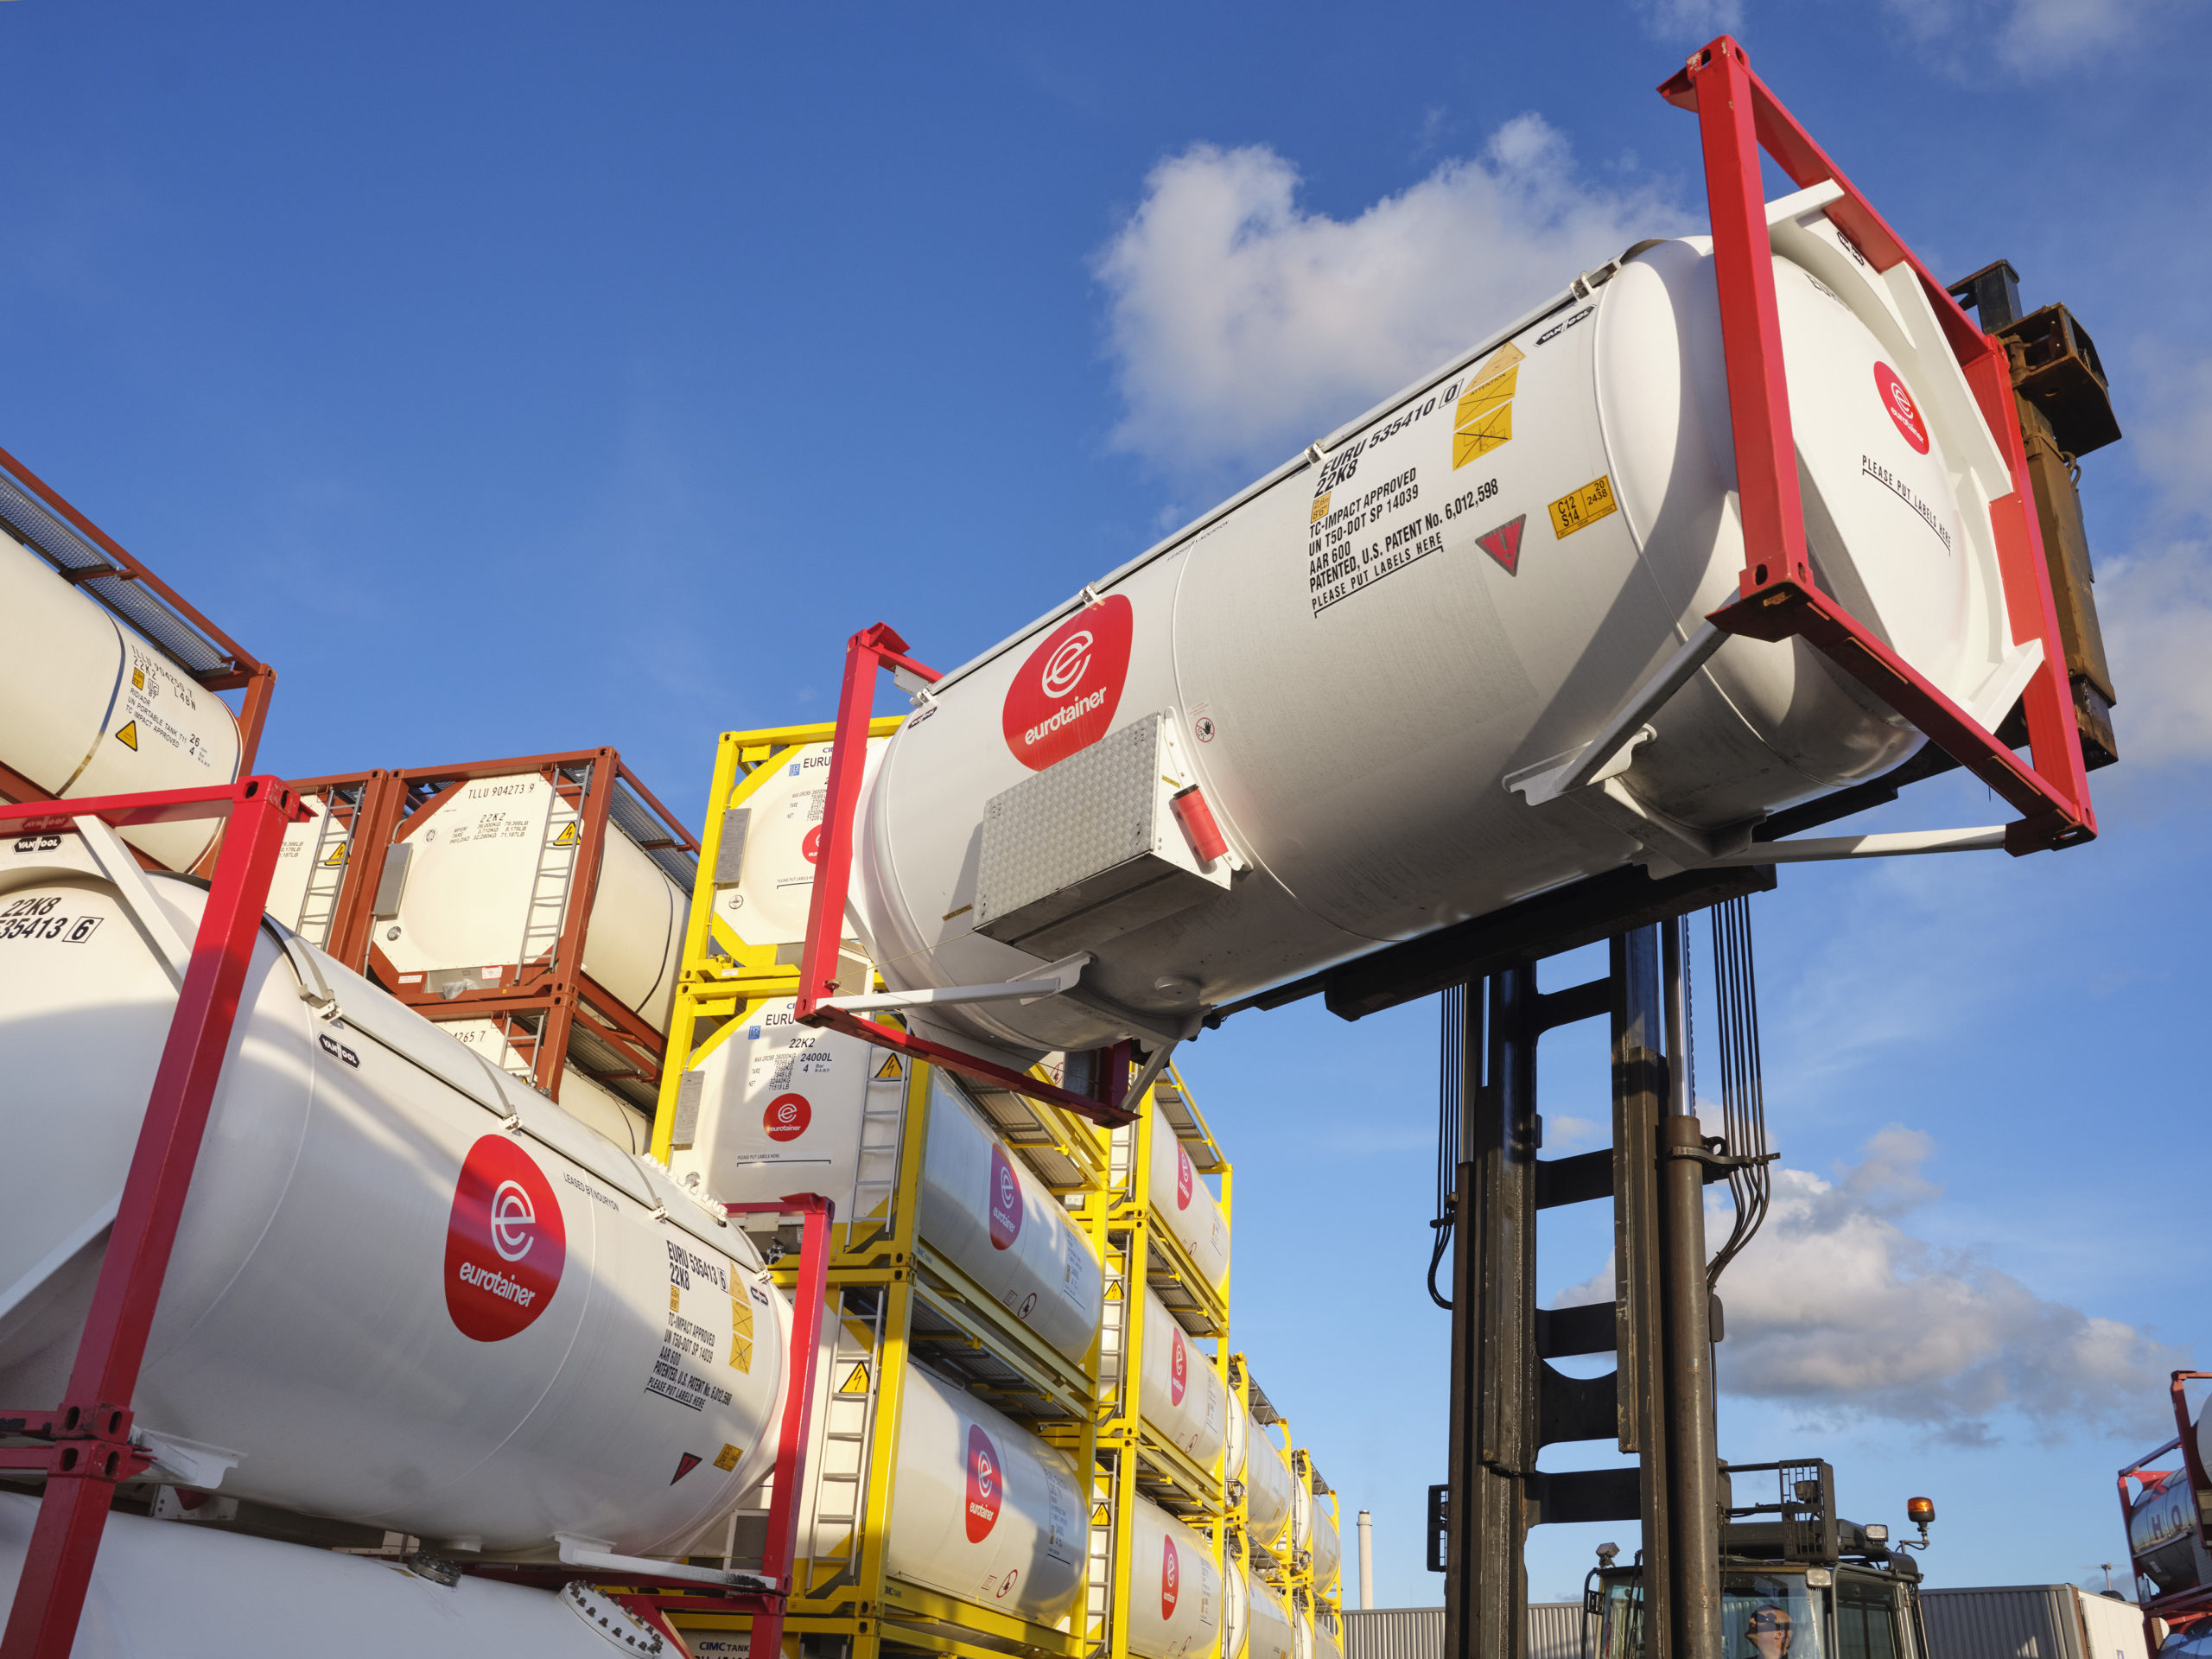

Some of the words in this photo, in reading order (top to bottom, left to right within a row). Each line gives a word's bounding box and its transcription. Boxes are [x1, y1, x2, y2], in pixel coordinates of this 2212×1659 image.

[1471, 372, 1507, 396] ATTENTION
[1319, 439, 1367, 479] EURU
[1369, 397, 1436, 449] 535410
[1445, 385, 1458, 404] 0
[1891, 406, 1924, 444] eurotainer
[1314, 459, 1358, 499] 22K8
[1594, 480, 1605, 492] 20
[1310, 498, 1362, 538] TC-IMPACT
[1363, 467, 1417, 509] APPROVED
[1558, 496, 1576, 514] C12
[1586, 488, 1608, 505] 2438
[1862, 454, 1892, 486] PLEASE
[1897, 480, 1911, 500] PUT
[1914, 494, 1936, 528] LABELS
[1939, 522, 1951, 548] HERE
[1309, 537, 1322, 557] UN
[1325, 513, 1367, 547] T50-DOT
[1370, 505, 1383, 523] SP
[1387, 484, 1419, 513] 14039
[1561, 509, 1580, 527] S14
[1310, 556, 1361, 593] PATENTED,
[1362, 543, 1383, 565] U.S.
[1385, 518, 1422, 552] PATENT
[1425, 512, 1443, 531] No.
[1445, 478, 1499, 521] 6,012,598
[1309, 550, 1329, 575] AAR
[1332, 540, 1351, 562] 600
[1312, 582, 1346, 610] PLEASE
[1351, 570, 1369, 589] PUT
[1375, 548, 1411, 577] LABELS
[1417, 531, 1443, 555] HERE
[131, 645, 151, 666] TLLU
[154, 664, 185, 692] 904250
[133, 655, 157, 681] 22K2
[174, 686, 196, 711] L4BN
[125, 705, 133, 714] TC
[134, 711, 153, 728] IMPACT
[153, 727, 180, 748] APPROVED
[127, 696, 136, 707] UN
[137, 702, 163, 727] PORTABLE
[165, 722, 177, 737] TANK
[1025, 686, 1107, 746] eurotainer
[189, 734, 200, 747] 26
[189, 747, 194, 755] 4
[804, 756, 831, 768] EURU
[468, 788, 489, 799] TLLU
[492, 784, 524, 797] 904273
[529, 783, 535, 793] 9
[480, 812, 506, 823] 22K2
[0, 897, 62, 918] 22K8
[0, 917, 68, 939] 35413
[72, 918, 94, 940] 6
[766, 1014, 795, 1026] EURU
[480, 1030, 486, 1042] 7
[789, 1038, 816, 1049] 22K2
[800, 1052, 833, 1062] 24000L
[803, 1064, 809, 1073] 4
[563, 1172, 585, 1192] LEASED
[593, 1191, 620, 1211] NOURYON
[993, 1206, 1016, 1233] eurotainer
[666, 1240, 689, 1268] EURU
[690, 1254, 718, 1286] 535413
[719, 1270, 727, 1290] 6
[670, 1262, 690, 1291] 22K8
[460, 1262, 536, 1307] eurotainer
[664, 1329, 672, 1344] UN
[674, 1332, 692, 1353] T50-DOT
[692, 1342, 699, 1357] SP
[668, 1312, 693, 1336] TC-IMPACT
[693, 1325, 715, 1347] APPROVED
[659, 1345, 670, 1362] AAR
[670, 1351, 681, 1366] 600
[648, 1376, 667, 1395] PLEASE
[667, 1383, 676, 1397] PUT
[676, 1386, 693, 1404] LABELS
[693, 1393, 706, 1408] HERE
[690, 1376, 705, 1392] PATENT
[969, 1501, 995, 1522] eurotainer
[699, 1642, 726, 1651] CIMC
